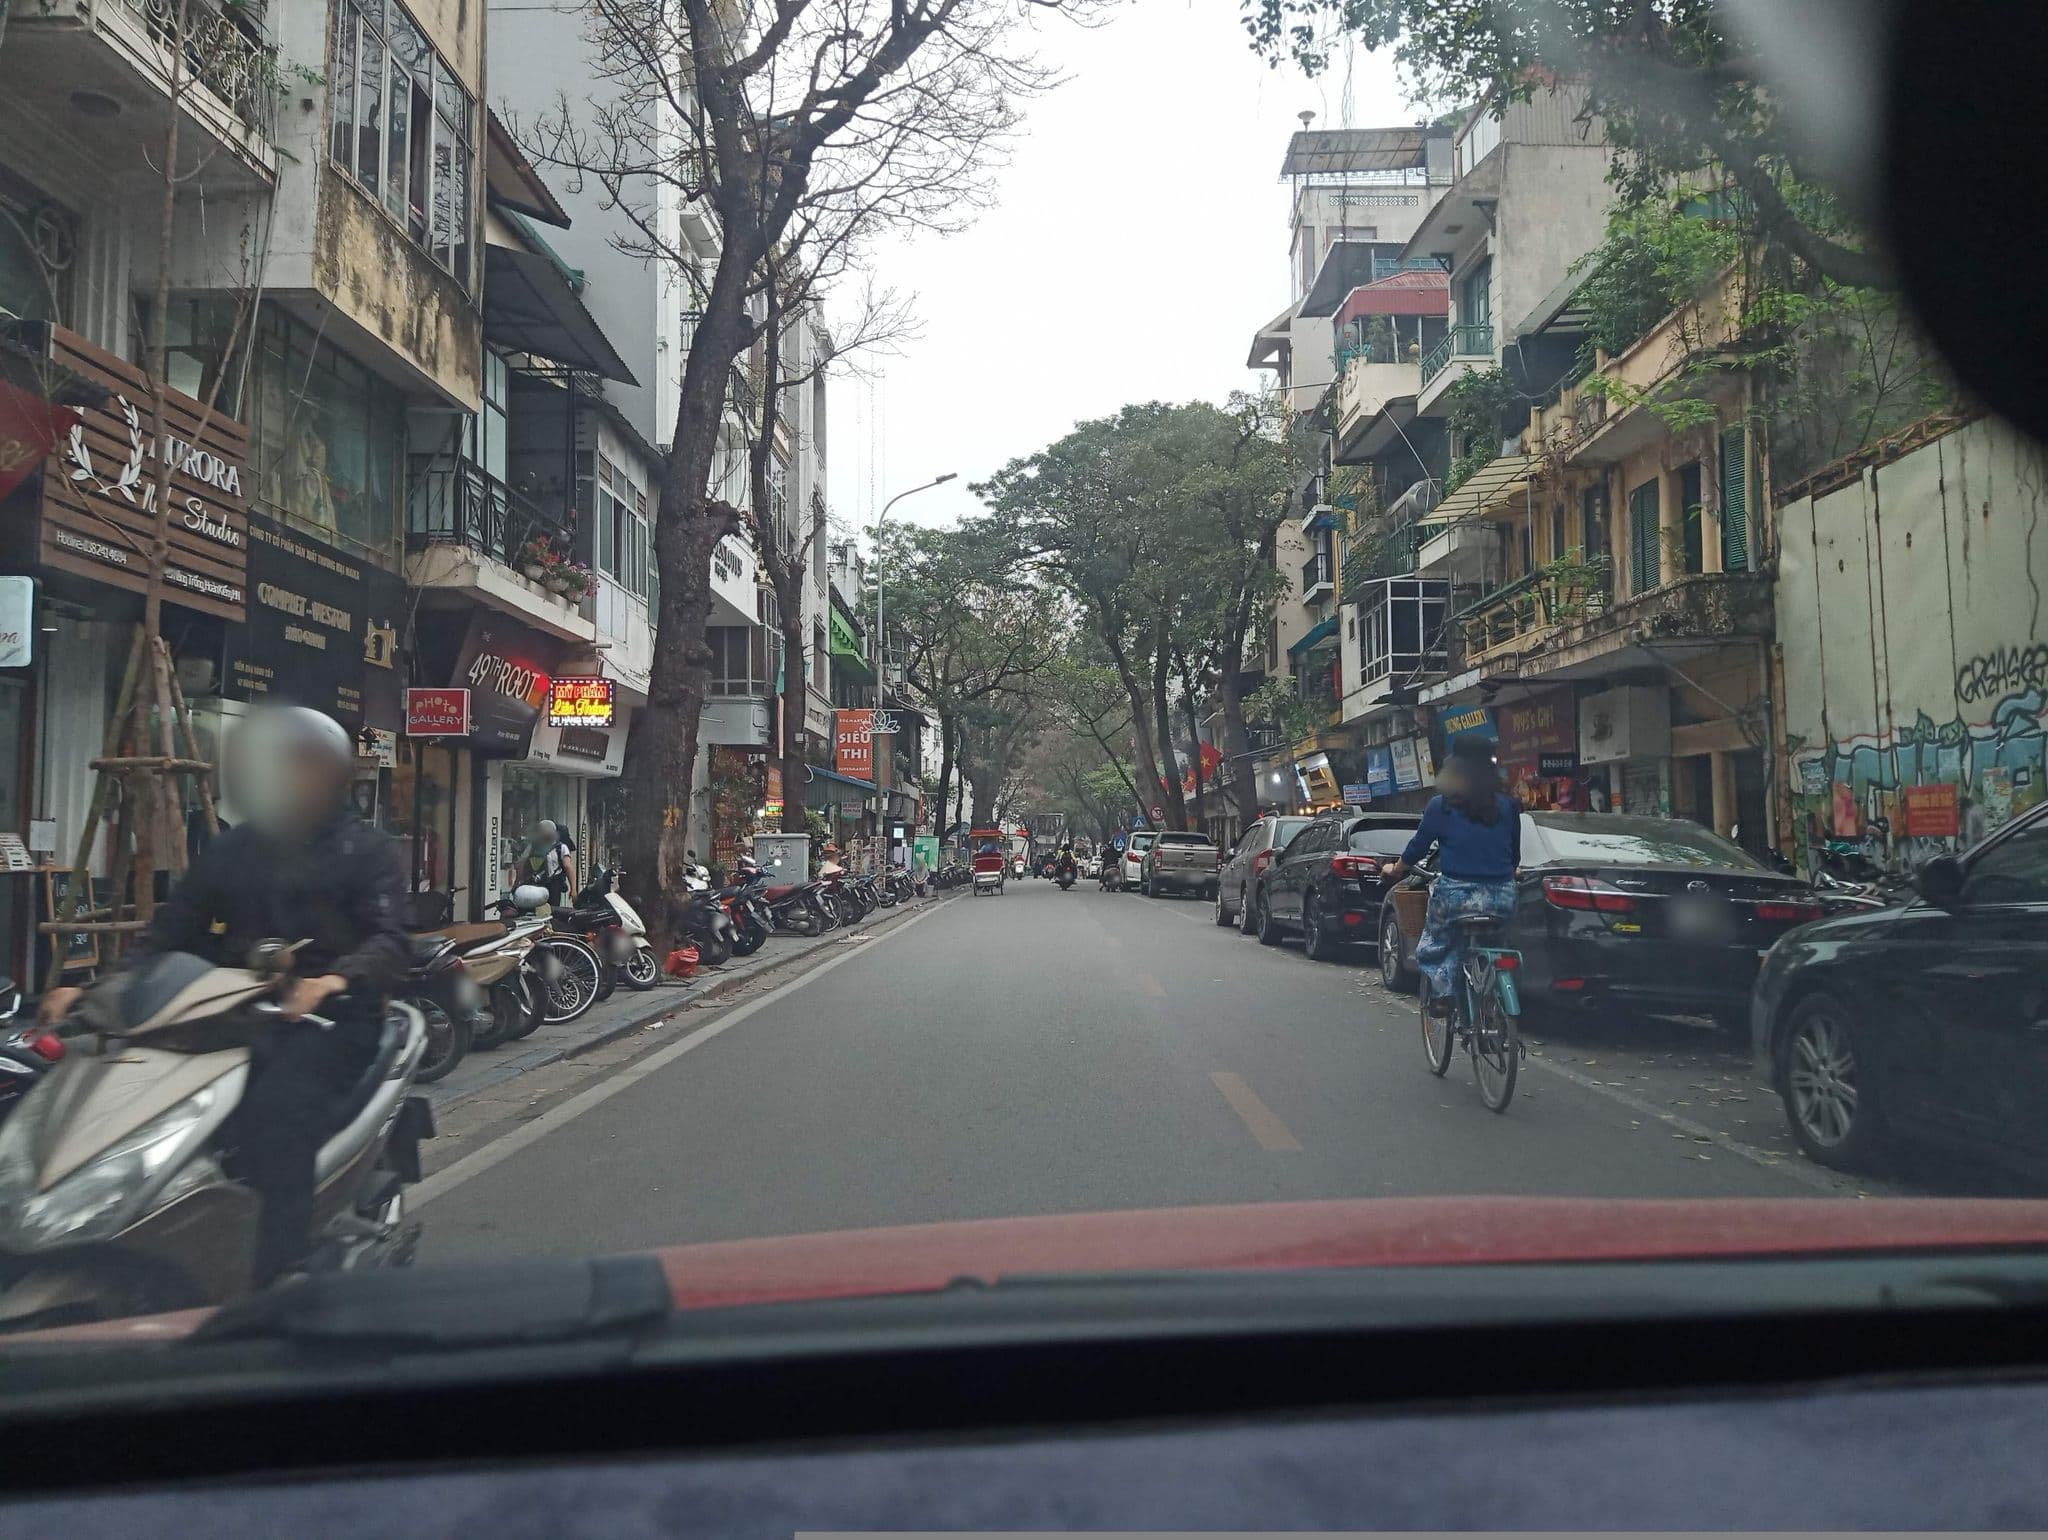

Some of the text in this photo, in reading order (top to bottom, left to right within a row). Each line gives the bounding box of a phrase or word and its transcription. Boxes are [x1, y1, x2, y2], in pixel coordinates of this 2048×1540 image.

[184, 497, 240, 546] Studio
[494, 662, 541, 702] ROOT
[409, 715, 463, 727] GALLERY
[838, 730, 871, 744] SIÊU
[840, 748, 868, 762] THỊ
